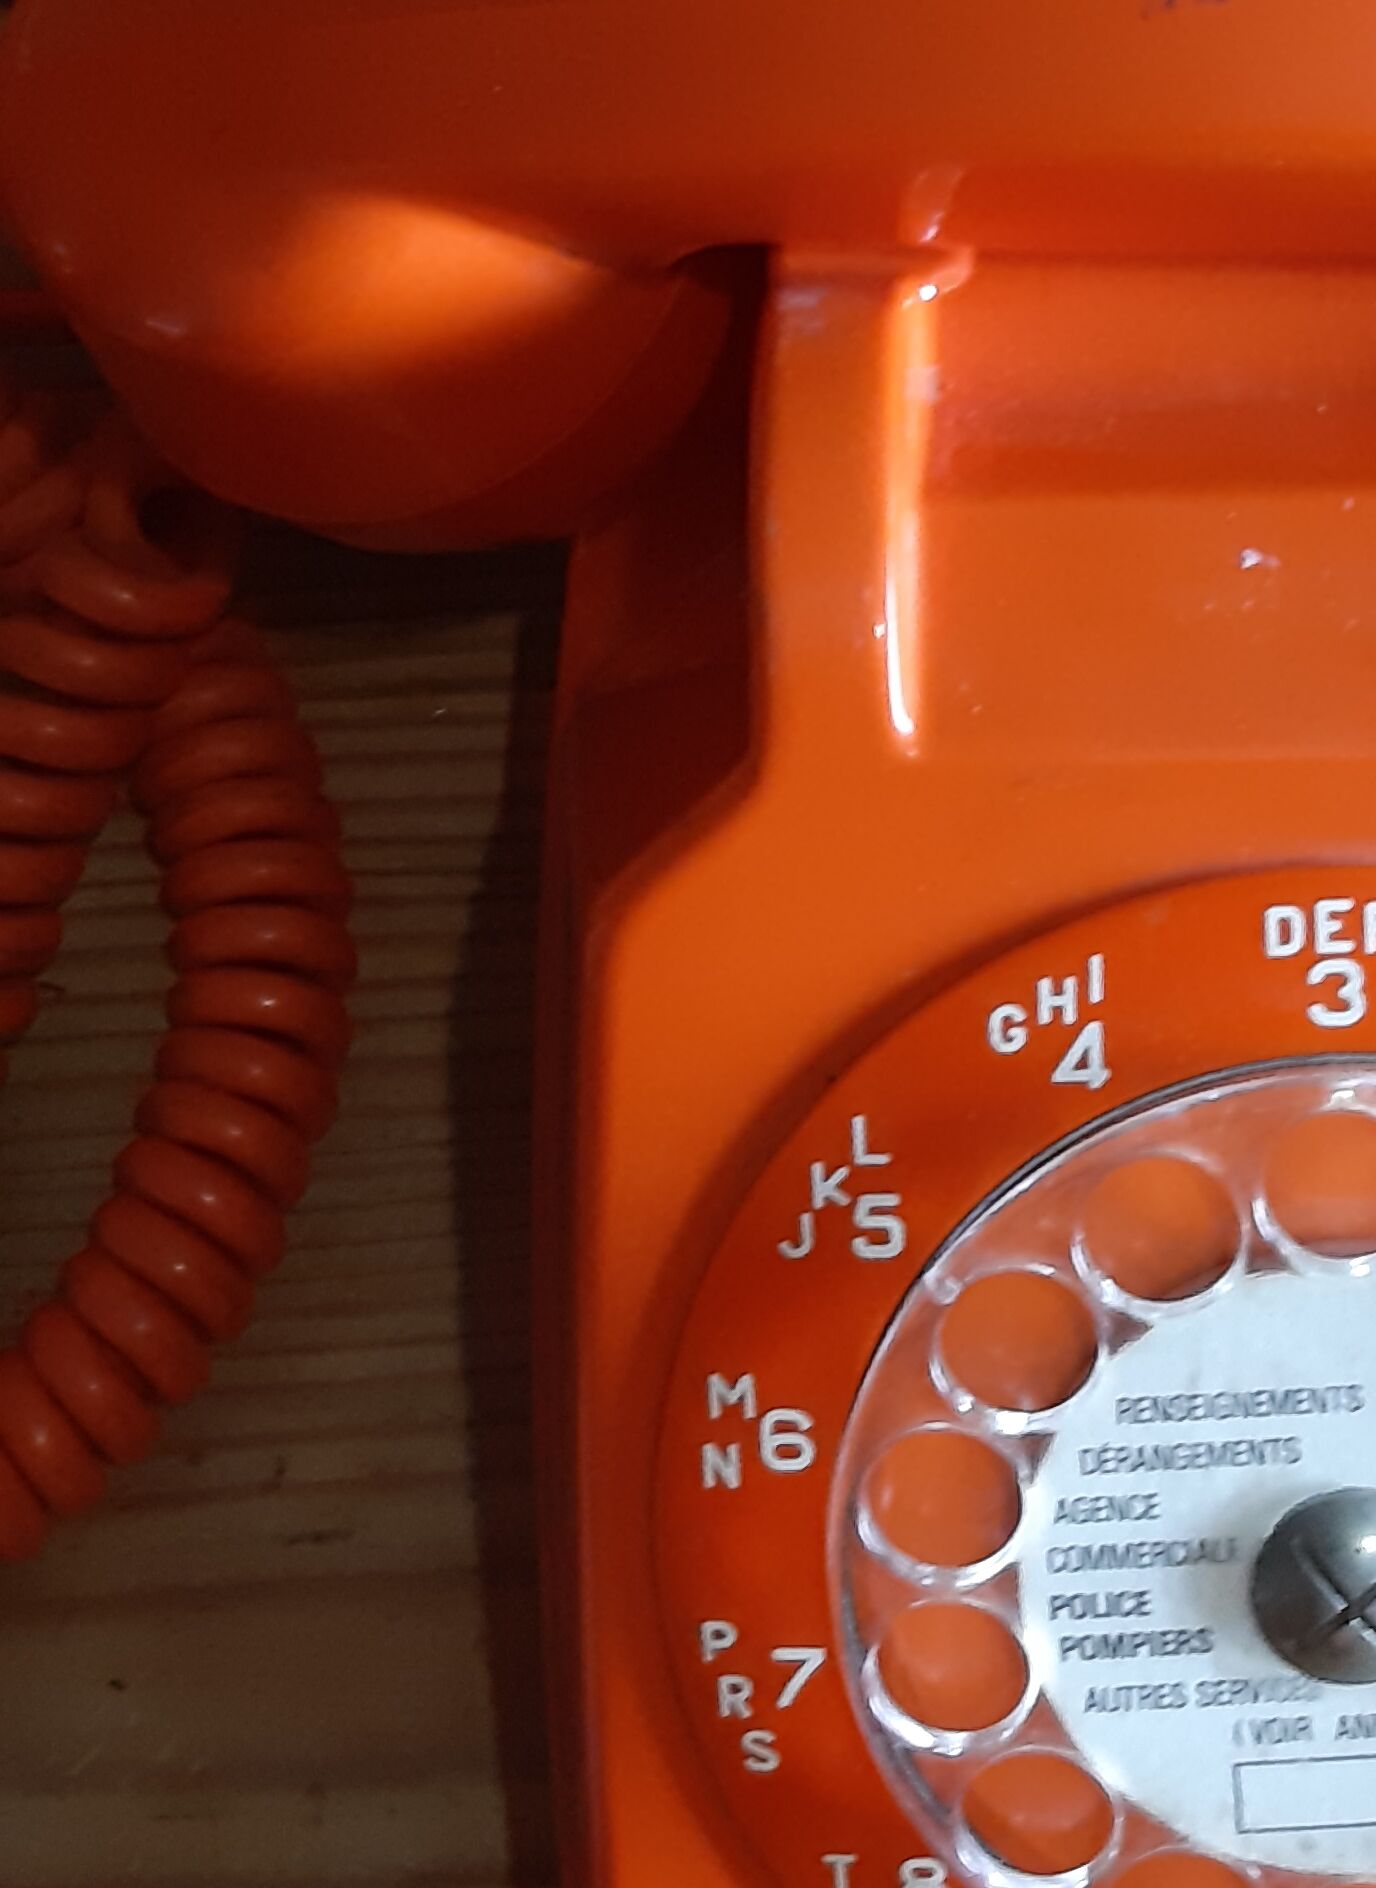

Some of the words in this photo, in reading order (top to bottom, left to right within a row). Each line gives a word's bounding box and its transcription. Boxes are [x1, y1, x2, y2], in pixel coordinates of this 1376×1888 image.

[1305, 956, 1368, 1029] 3
[1050, 1020, 1113, 1090] 4
[851, 1193, 907, 1261] 5
[1114, 1384, 1365, 1424] RENSEIGNEMENTS
[758, 1408, 816, 1473] 6
[1078, 1436, 1303, 1476] DÉRANGEMENTS
[1053, 1492, 1161, 1525] AGENCE
[1049, 1589, 1151, 1620] POLICE
[1059, 1626, 1214, 1662] POMPIERS
[770, 1646, 828, 1710] 7
[1084, 1681, 1187, 1712] AUTRES
[1232, 1715, 1313, 1746] (VOIR
